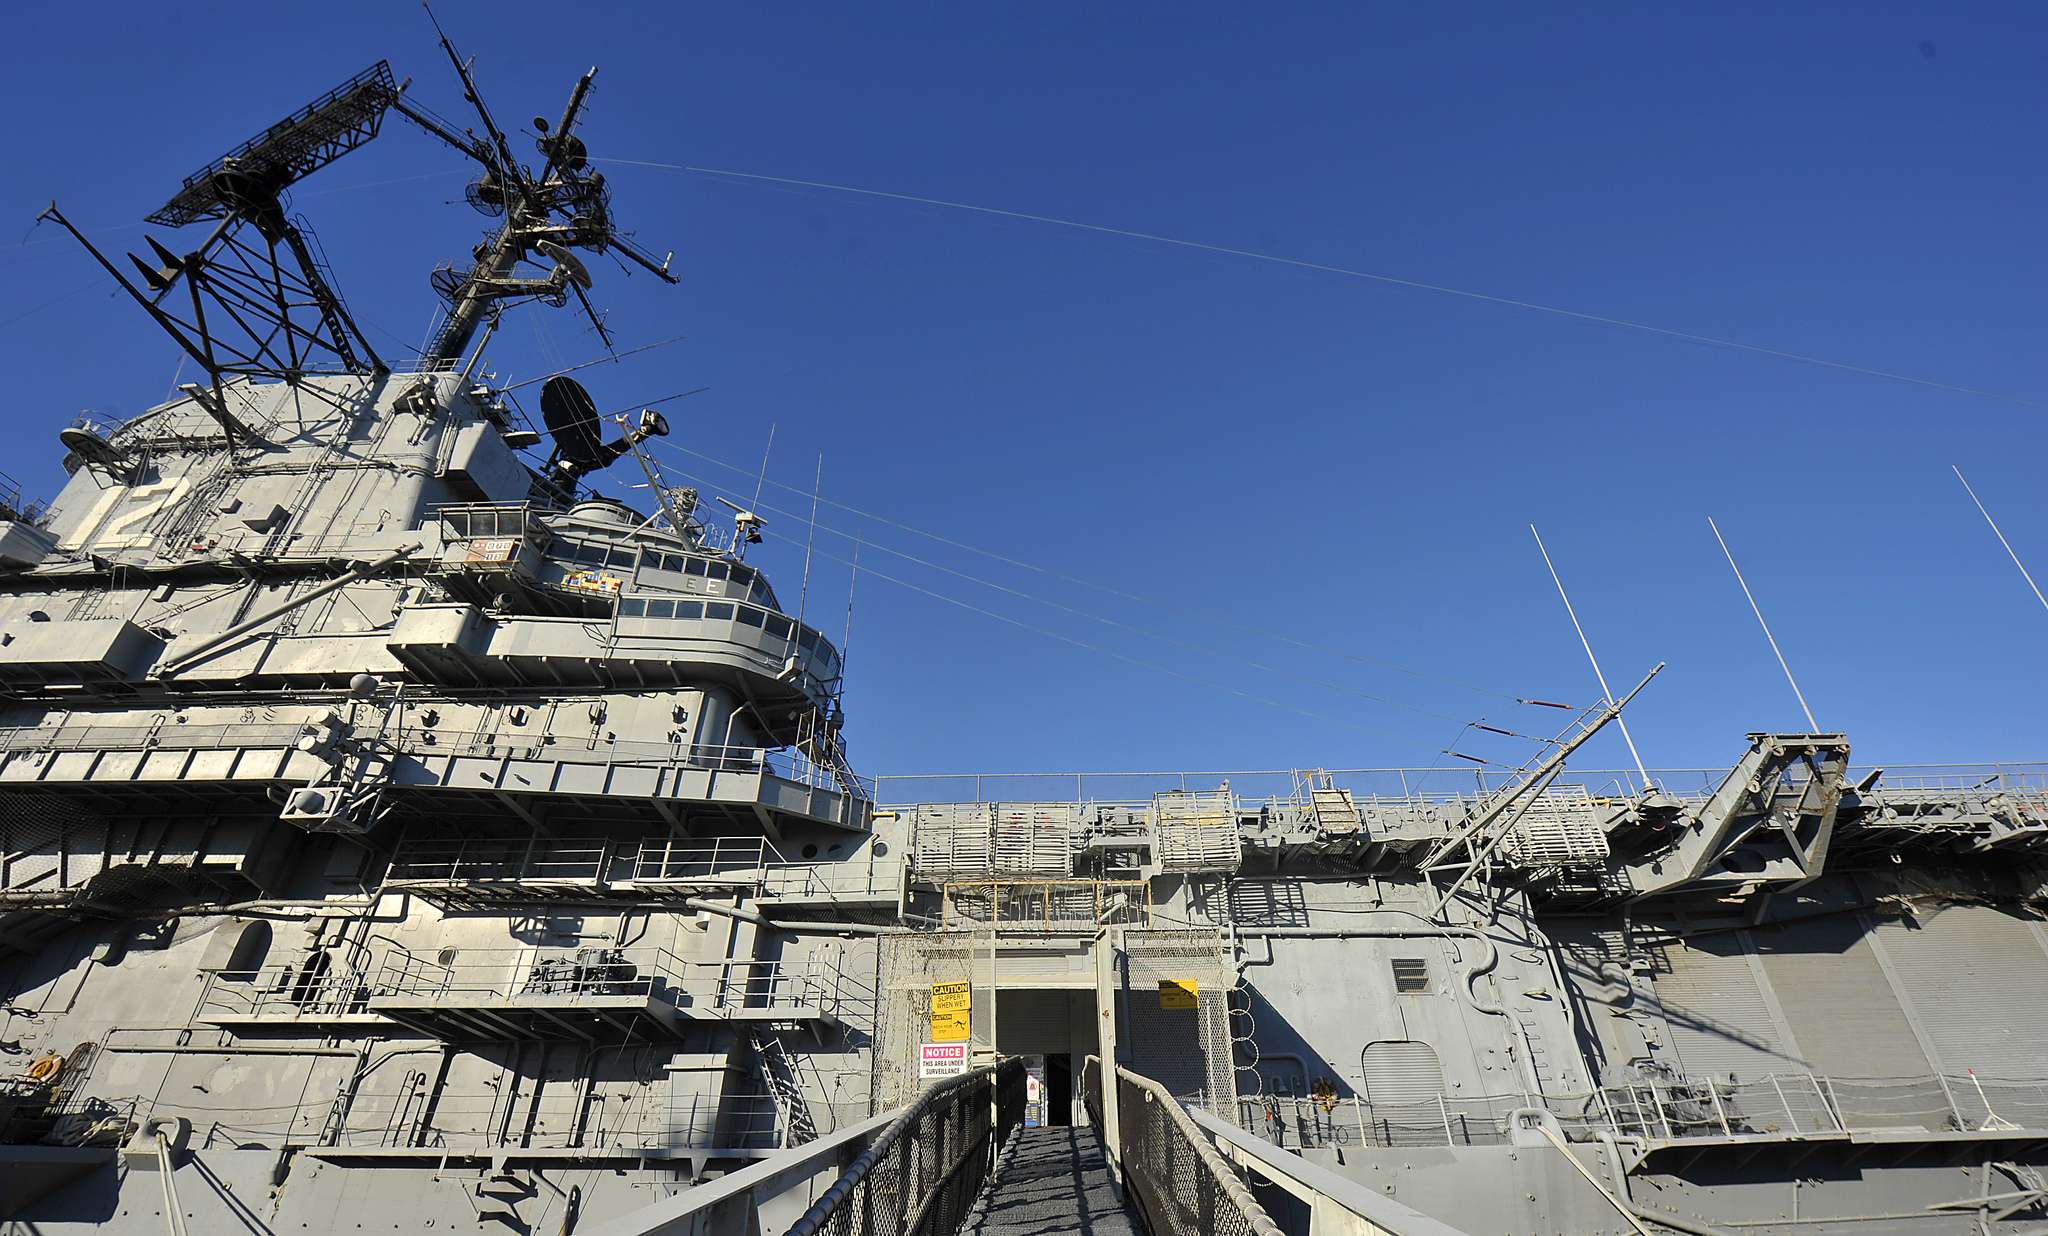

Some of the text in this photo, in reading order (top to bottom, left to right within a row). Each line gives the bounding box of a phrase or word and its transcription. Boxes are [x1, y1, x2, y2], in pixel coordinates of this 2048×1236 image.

[58, 477, 191, 549] 12
[706, 578, 721, 594] E
[933, 984, 968, 995] CAUTION
[938, 994, 964, 1002] SLIPPERY
[937, 1001, 954, 1009] WHEN
[926, 1047, 961, 1057] NOTICE
[926, 1067, 960, 1075] SURVEILLANCE
